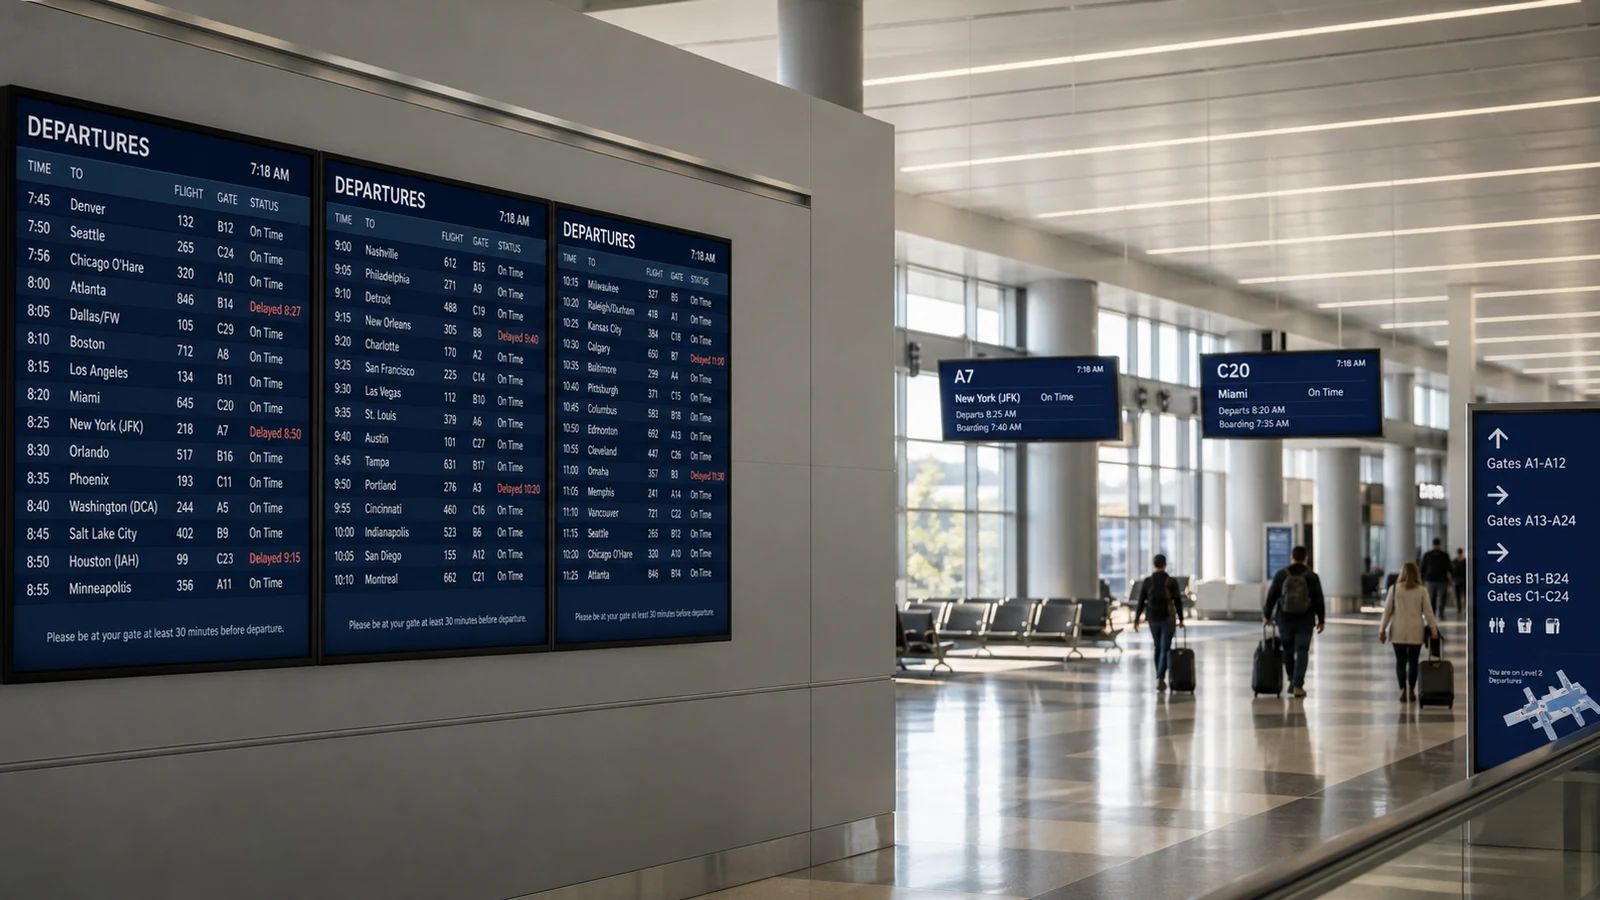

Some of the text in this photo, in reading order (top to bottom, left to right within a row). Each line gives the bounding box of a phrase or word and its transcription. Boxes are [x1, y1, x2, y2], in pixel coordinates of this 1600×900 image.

[28, 115, 149, 157] DEPARTURES
[251, 162, 289, 181] 7:18 AM
[28, 160, 279, 211] TIME TO FLIGHT GATE STATUS
[335, 176, 425, 209] DEPARTURES
[28, 191, 283, 241] 7:45 Denver 132 B12 On Time
[499, 211, 529, 226] 7:18 AM
[335, 213, 521, 253] TIME TO FLIGHT GATE STATUS
[564, 221, 635, 249] DEPARTURES
[691, 249, 715, 263] 7:18 AM
[28, 247, 283, 290] 7:56 Chicago O'Hare 320 A10 On Time
[563, 253, 577, 263] TIME
[588, 257, 595, 267] TO
[671, 272, 683, 281] GATE
[690, 275, 709, 285] STATUS
[28, 276, 301, 316] 8:00 Atlanta 846 B14 Delayed 8:27
[335, 311, 351, 323] 9:15
[365, 315, 382, 327] New
[383, 317, 411, 330] Orleans
[444, 324, 457, 335] 305
[473, 327, 482, 338] B8
[335, 335, 524, 364] 9:20 Charlotte 170 A2 On Time
[954, 369, 974, 383] A7
[1217, 363, 1250, 378] C20
[27, 387, 283, 414] 8:20 Miami 645 C20 On Time
[955, 393, 1074, 404] New York (JFK) On Time
[1218, 388, 1343, 398] Miami On Time
[956, 411, 984, 420] Departs
[1219, 407, 1250, 416] Departs
[1252, 406, 1269, 414] 8:20
[27, 415, 302, 440] 8:25 New York (JFK) 218 A7 Delayed 8:50
[957, 423, 988, 433] Boarding
[991, 423, 1007, 431] 7:40
[1219, 419, 1254, 430] Boarding
[1257, 419, 1274, 427] 7:35
[1487, 457, 1566, 469] Gates A1-A12
[563, 486, 712, 500] 11:05 Memphis 241 A14 On Time
[563, 507, 712, 519] 11:10 Vancouver 721 C22 On Time
[1487, 515, 1576, 526] Gates A13-A24
[335, 526, 523, 540] 10:00 Indianapolis 523 B6 On Time
[27, 552, 301, 569] 8:50 Houston (IAH) 99 C23 Delayed 9:15
[335, 571, 523, 585] 10:10 Montreal 662 C21 On Time
[1487, 572, 1569, 584] Gates B1-B24
[1487, 590, 1569, 602] Gates C1-C24
[47, 625, 284, 642] Please be at your gate at least 30 minutes before departure.
